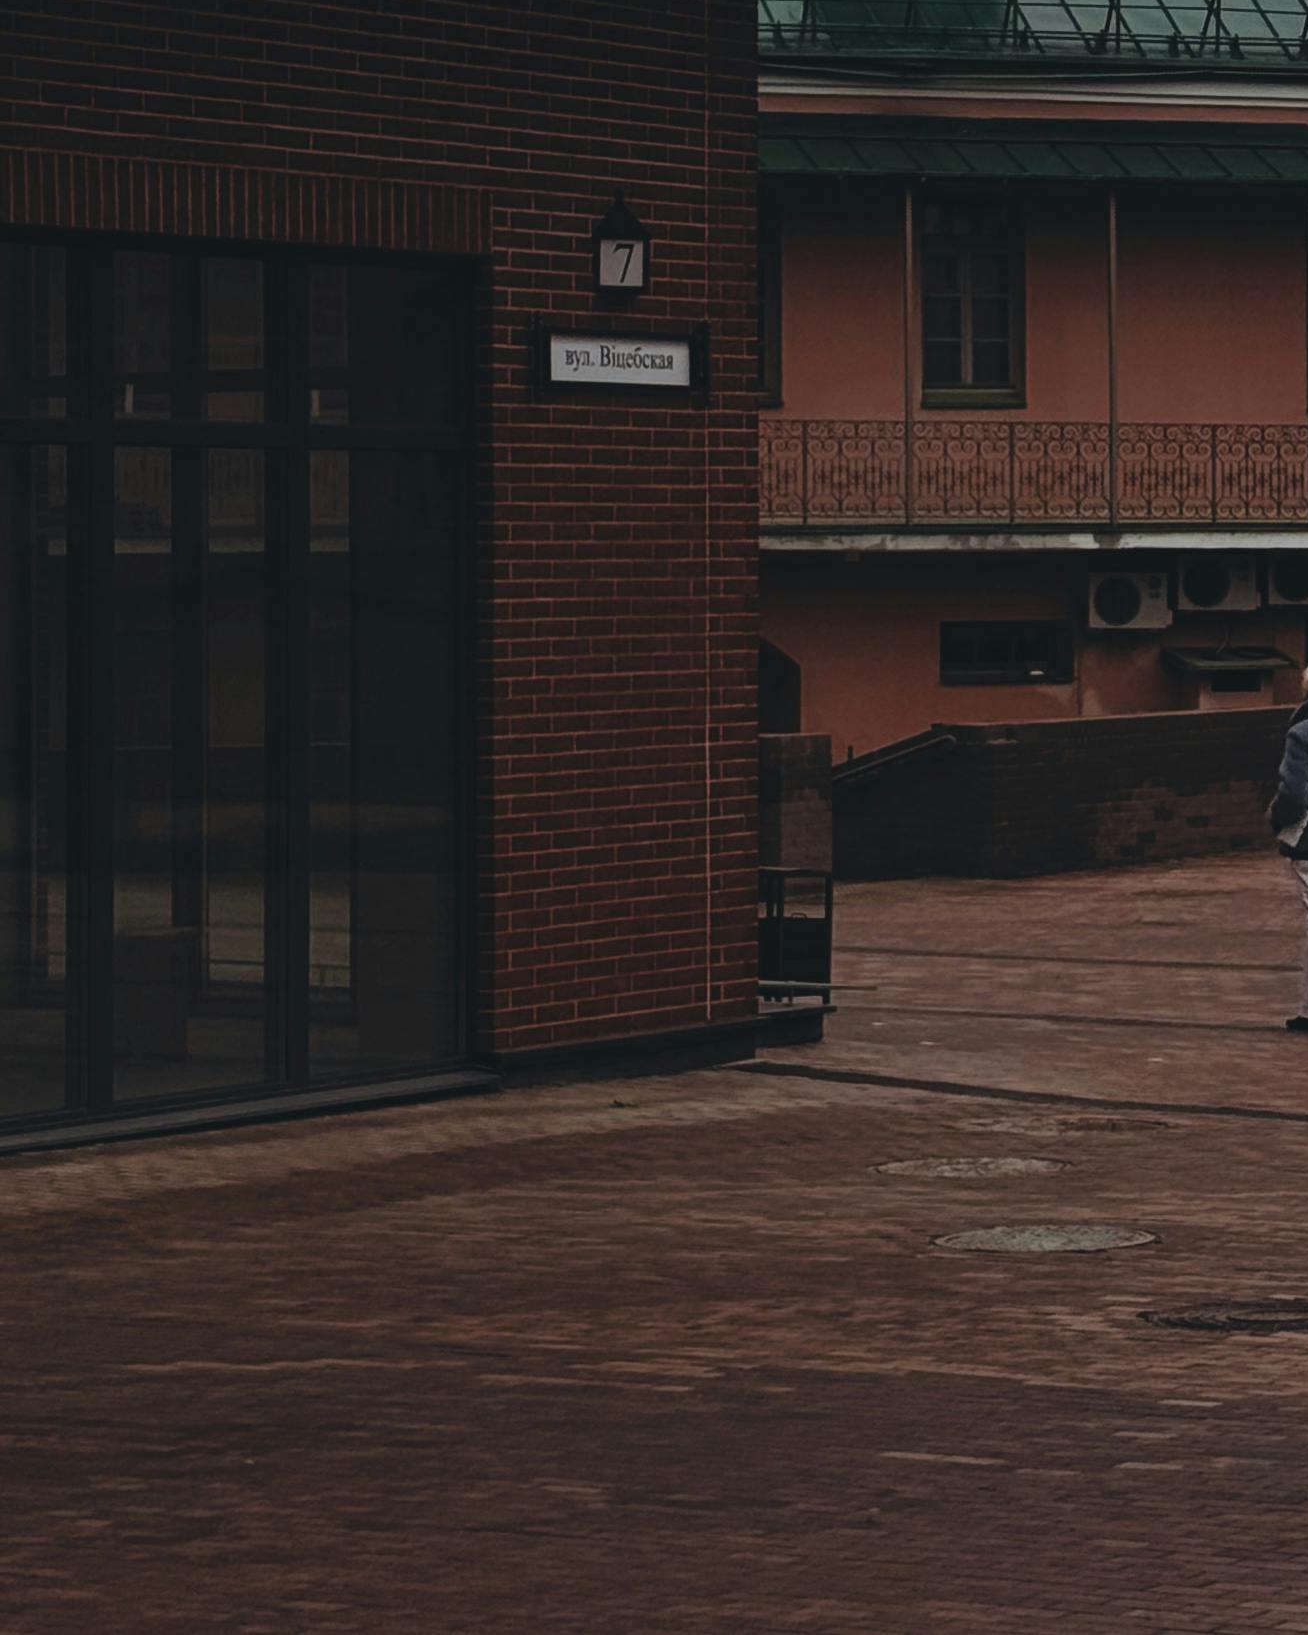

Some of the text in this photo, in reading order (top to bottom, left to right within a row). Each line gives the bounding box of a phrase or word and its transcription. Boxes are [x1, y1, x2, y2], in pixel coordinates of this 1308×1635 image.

[612, 243, 636, 284] 7
[565, 344, 674, 372] вул. Віцебская
